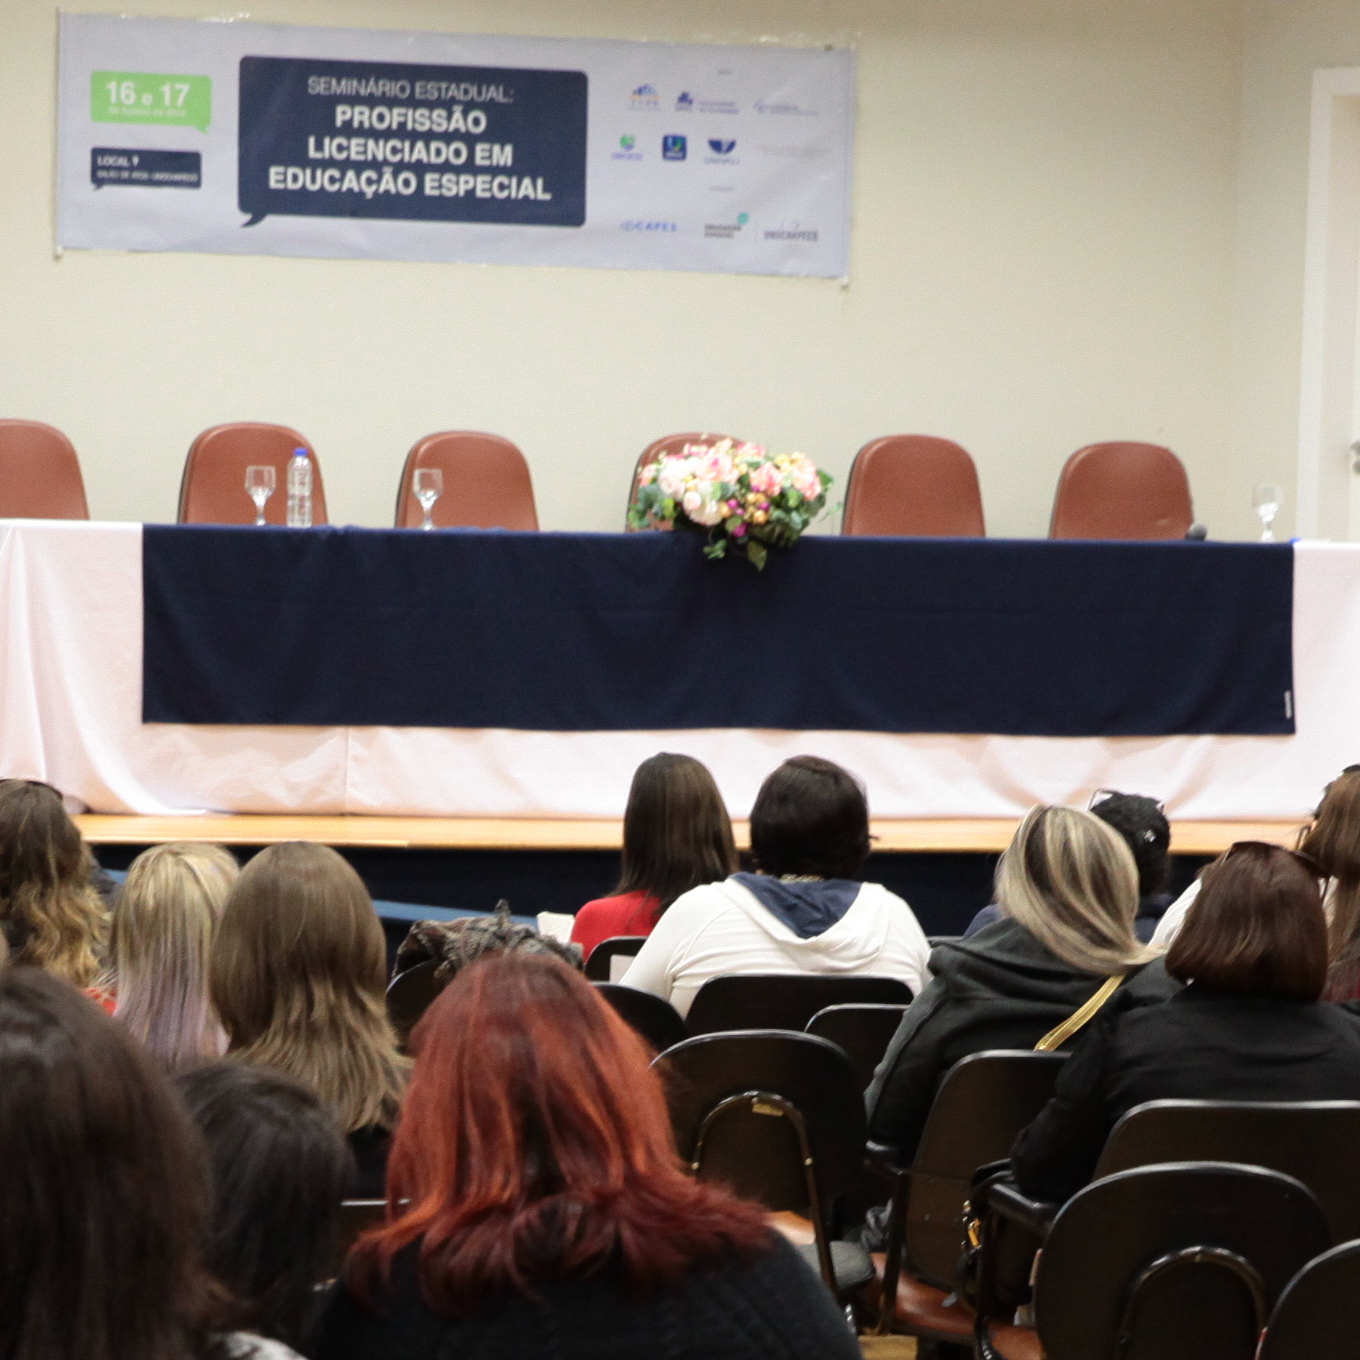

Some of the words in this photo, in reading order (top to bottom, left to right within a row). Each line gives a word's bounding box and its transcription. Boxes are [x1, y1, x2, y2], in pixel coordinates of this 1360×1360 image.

[106, 80, 137, 106] 16
[141, 93, 154, 106] e
[160, 82, 191, 108] 17
[308, 76, 411, 99] SEMINÁRIO
[415, 79, 515, 104] ESTADUAL:
[335, 103, 488, 135] PROFISSÃO
[307, 135, 468, 165] LICENCIADO
[475, 143, 514, 167] EM
[268, 165, 418, 200] EDUCAÇÃO
[423, 171, 552, 201] ESPECIAL
